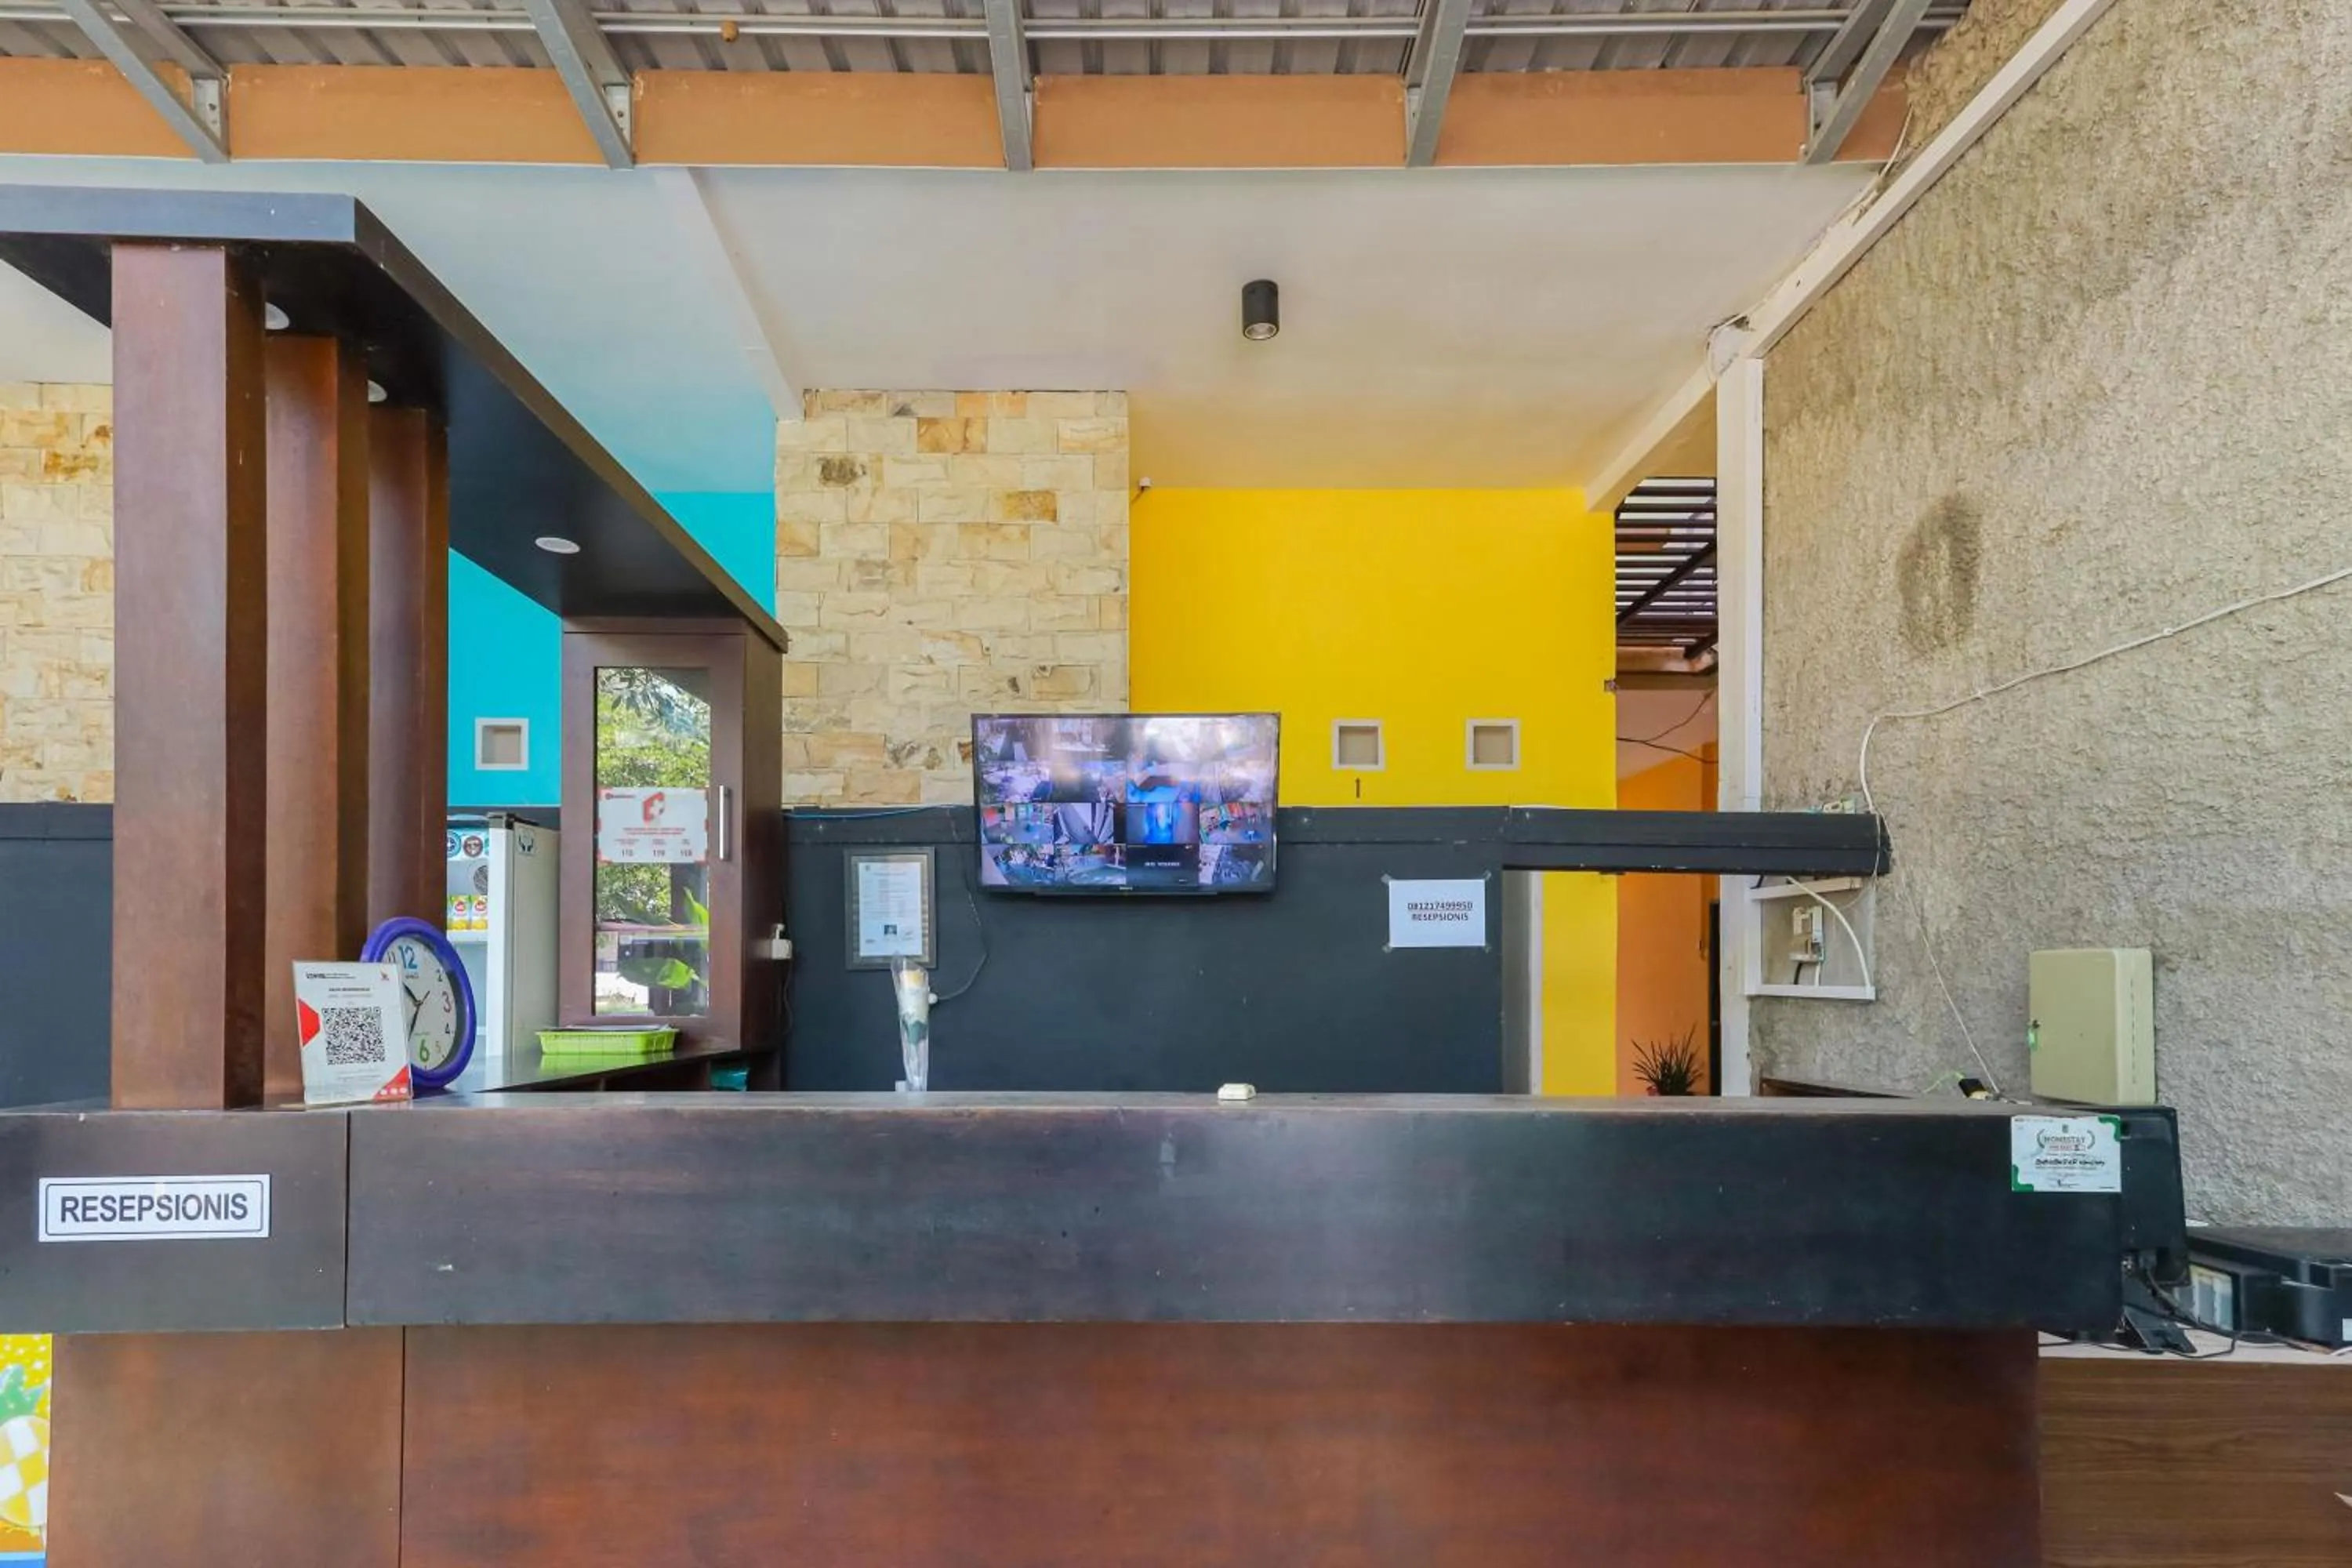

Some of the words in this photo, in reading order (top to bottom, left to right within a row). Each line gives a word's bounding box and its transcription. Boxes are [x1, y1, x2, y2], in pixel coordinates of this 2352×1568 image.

[398, 945, 418, 970] 12
[442, 990, 452, 1013] 3
[445, 1022, 451, 1034] 4
[419, 1039, 430, 1062] 6
[60, 1192, 249, 1223] RESEPSIONIS
